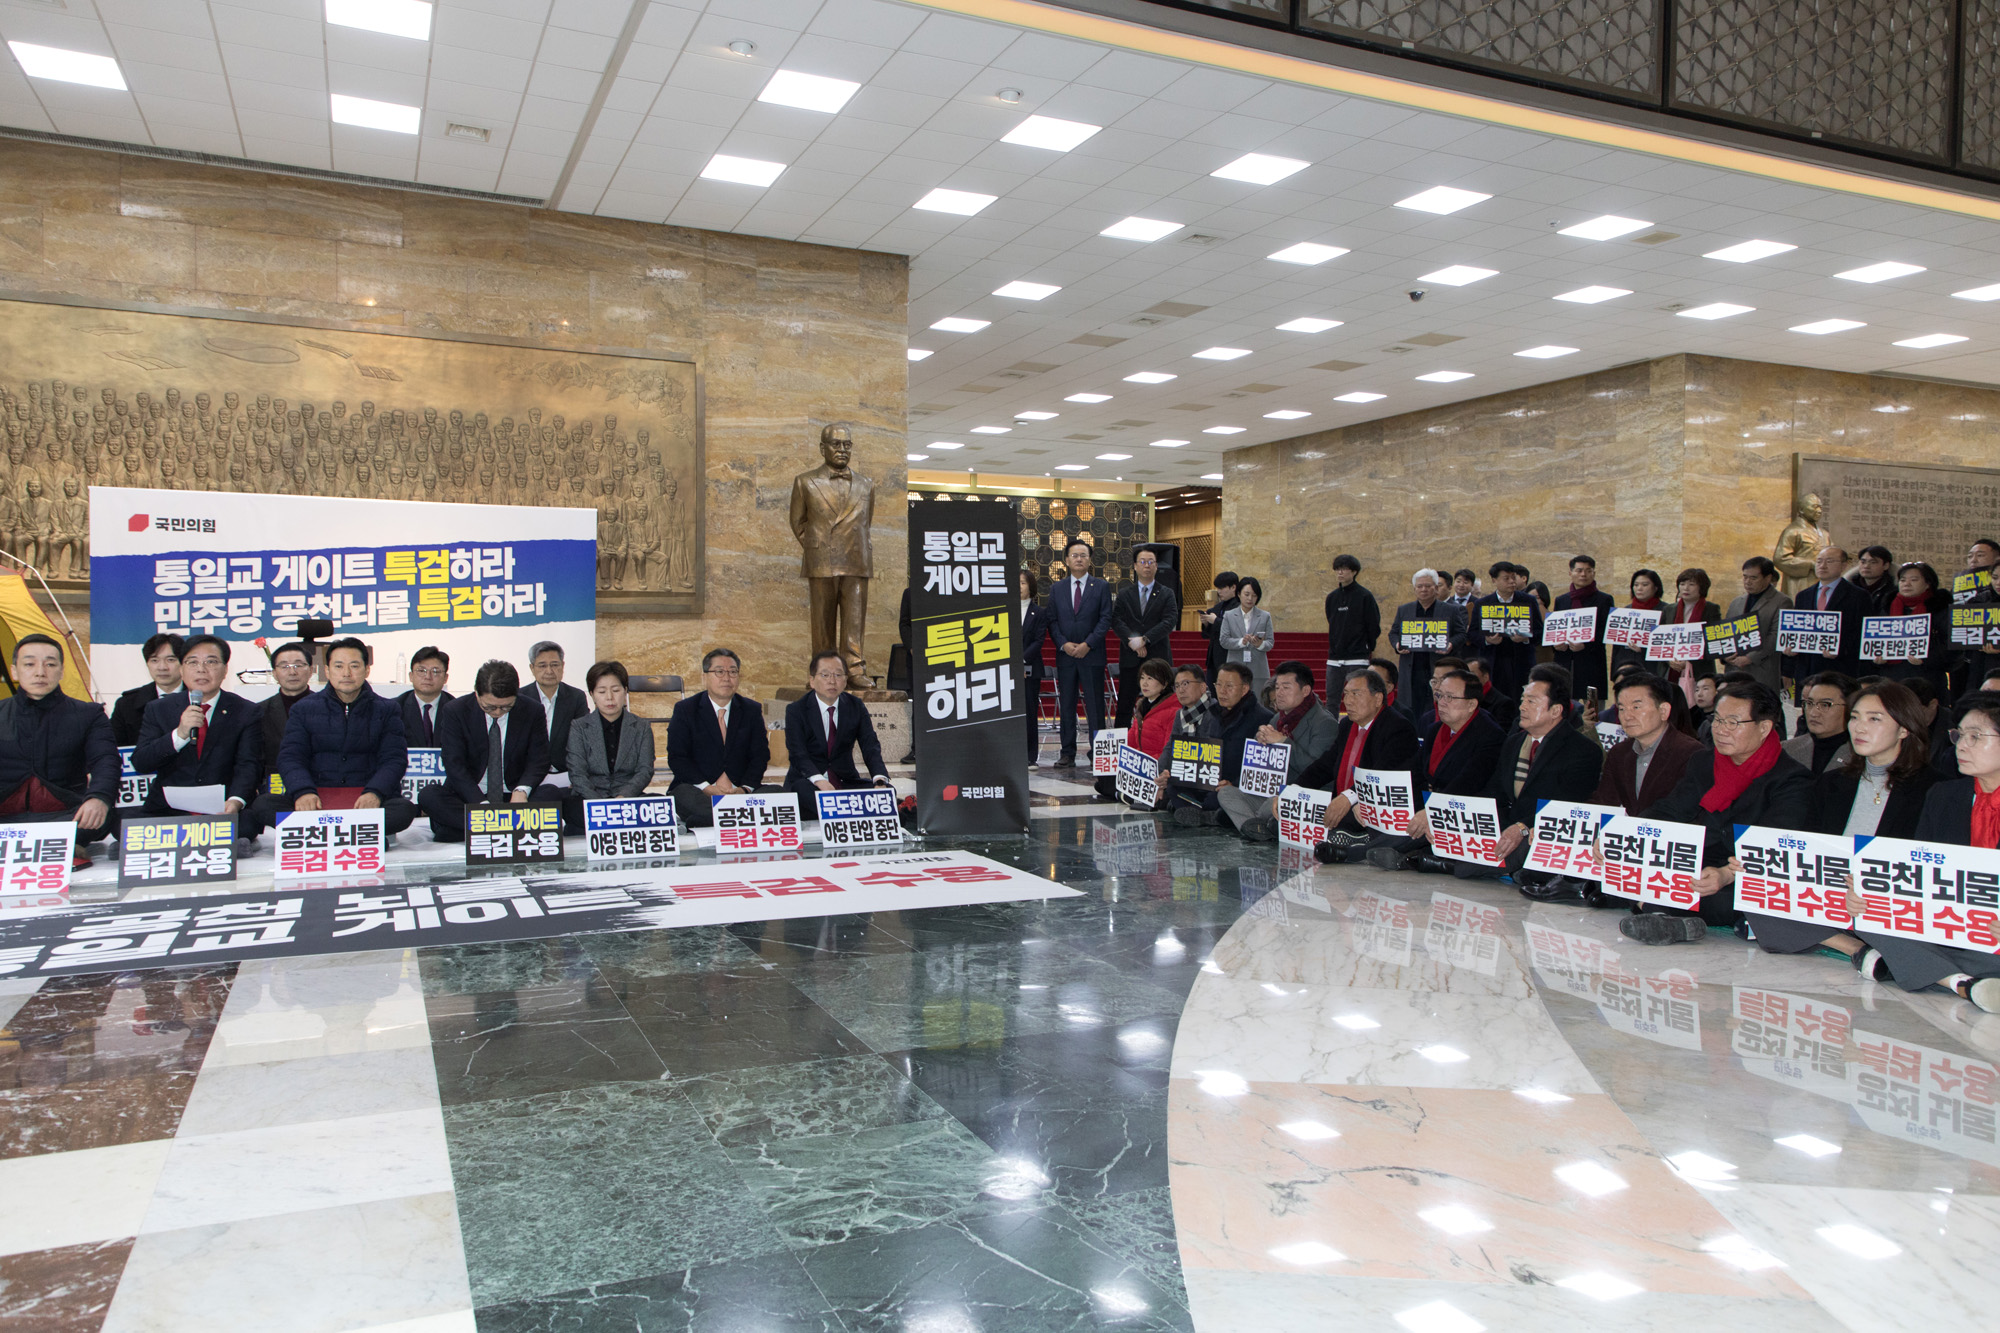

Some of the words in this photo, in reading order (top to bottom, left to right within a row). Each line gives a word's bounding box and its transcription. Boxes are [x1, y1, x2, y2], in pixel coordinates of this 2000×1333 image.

[155, 517, 216, 533] 국민의힘
[923, 531, 1006, 562] 통일교
[153, 558, 263, 596] 통일교
[272, 554, 377, 590] 게이트
[383, 548, 514, 584] 특검하라
[924, 565, 1007, 595] 게이트
[1954, 573, 1976, 592] 통일교
[154, 600, 263, 635] 민주당
[272, 589, 410, 632] 공천뇌물
[417, 583, 546, 623] 특검하라
[1481, 606, 1505, 618] 통일교
[1506, 606, 1530, 618] 게이트
[1952, 609, 1984, 626] 통일교
[1402, 621, 1423, 633] 통일교
[1425, 621, 1447, 633] 게이트
[1481, 619, 1505, 633] 특검
[1545, 630, 1567, 642] 특검
[1570, 628, 1592, 640] 수용
[1547, 618, 1568, 631] 공천
[1571, 615, 1593, 628] 뇌물
[1609, 616, 1631, 629] 공천
[1633, 618, 1656, 631] 뇌물
[1705, 622, 1734, 640] 통일교
[1733, 615, 1759, 635] 게이트
[1783, 614, 1815, 630] 무도한
[1816, 615, 1838, 631] 여당
[1867, 620, 1903, 636] 무도한
[1905, 618, 1927, 635] 여당
[925, 612, 1010, 668] 특검
[1401, 635, 1423, 648] 특검
[1424, 635, 1447, 648] 수용
[1607, 629, 1628, 642] 특검
[1652, 632, 1676, 645] 공천
[1679, 631, 1702, 644] 뇌물
[1708, 638, 1736, 655] 특검
[1738, 631, 1761, 650] 수용
[1780, 633, 1798, 649] 야당
[1799, 634, 1818, 650] 탄압
[1819, 635, 1838, 652] 중단
[1863, 640, 1884, 657] 야당
[1886, 640, 1907, 656] 탄압
[1908, 638, 1927, 656] 중단
[1951, 627, 1983, 645] 특검
[1987, 627, 2000, 645] 수
[1649, 646, 1674, 658] 특검
[1677, 645, 1701, 658] 수용
[926, 664, 1015, 720] 하라
[1095, 740, 1110, 756] 공천
[1173, 740, 1199, 760] 통일교
[1200, 743, 1221, 764] 게이트
[1246, 744, 1269, 766] 무도한
[1269, 747, 1286, 769] 여당
[406, 753, 437, 774] 도한
[1095, 757, 1110, 772] 특검
[1112, 757, 1117, 771] 수
[1121, 749, 1141, 773] 무도한
[1142, 759, 1156, 779] 여당
[1171, 760, 1197, 782] 특검
[1199, 765, 1220, 786] 수용
[962, 786, 1004, 799] 국민의힘
[1118, 770, 1128, 790] 야당
[1128, 776, 1141, 797] 탄압
[1142, 781, 1156, 803] 중단
[1241, 769, 1255, 790] 야당
[1255, 771, 1269, 793] 탄압
[1269, 774, 1283, 795] 중단
[1355, 780, 1375, 804] 공천
[1376, 785, 1409, 807] 뇌물
[591, 804, 638, 827] 무도한
[639, 802, 670, 824] 여당
[718, 806, 756, 827] 공천
[760, 805, 796, 826] 뇌물
[822, 795, 863, 816] 무도한
[865, 793, 892, 814] 여당
[1281, 798, 1301, 820] 공천
[1303, 802, 1327, 825] 뇌물
[1360, 803, 1379, 827] 특검
[1380, 809, 1410, 831] 수용
[1448, 801, 1465, 810] 민주당
[1570, 809, 1590, 819] 민주당
[319, 816, 343, 824] 민주당
[470, 809, 513, 832] 통일교
[516, 808, 558, 830] 게이트
[824, 822, 848, 844] 야당
[851, 820, 874, 842] 탄압
[876, 819, 899, 841] 중단
[1281, 819, 1300, 842] 특검
[1429, 806, 1460, 832] 공천
[1461, 812, 1496, 837] 뇌물
[1538, 816, 1577, 844] 공천
[1578, 822, 1600, 846] 뇌
[1637, 826, 1662, 837] 민주당
[126, 825, 178, 851] 통일교
[182, 822, 232, 847] 게이트
[281, 826, 327, 849] 공천
[334, 824, 379, 846] 뇌물
[470, 833, 513, 858] 특검
[518, 832, 559, 856] 수용
[591, 832, 617, 856] 야당
[620, 831, 646, 854] 탄압
[650, 829, 675, 852] 중단
[720, 828, 757, 849] 특검
[762, 827, 798, 847] 수용
[1434, 830, 1464, 856] 특검
[1466, 837, 1498, 862] 수용
[1778, 838, 1807, 850] 민주당
[13, 838, 67, 863] 뇌물
[281, 850, 327, 873] 특검
[334, 847, 379, 871] 수용
[1532, 843, 1569, 869] 특검
[1573, 849, 1601, 875] 수
[1604, 832, 1645, 864] 공천
[1650, 841, 1697, 872] 뇌물
[1910, 850, 1946, 865] 민주당
[124, 852, 176, 879] 특검
[182, 848, 232, 876] 수용
[1741, 844, 1790, 880] 공천
[1797, 853, 1850, 889] 뇌물
[11, 865, 64, 890] 수용
[669, 876, 847, 899] 특검
[856, 866, 1012, 887] 수용
[1604, 861, 1642, 895] 특검
[1647, 871, 1694, 904] 수용
[1861, 858, 1923, 898] 공천
[1932, 867, 1999, 909] 뇌물
[66, 898, 304, 940] 공천
[334, 878, 531, 914] 뇌물
[1741, 876, 1790, 913] 특검
[1798, 887, 1852, 923] 수용
[332, 888, 642, 938] 게이트
[1861, 893, 1924, 934] 특검
[1933, 906, 1999, 946] 수용
